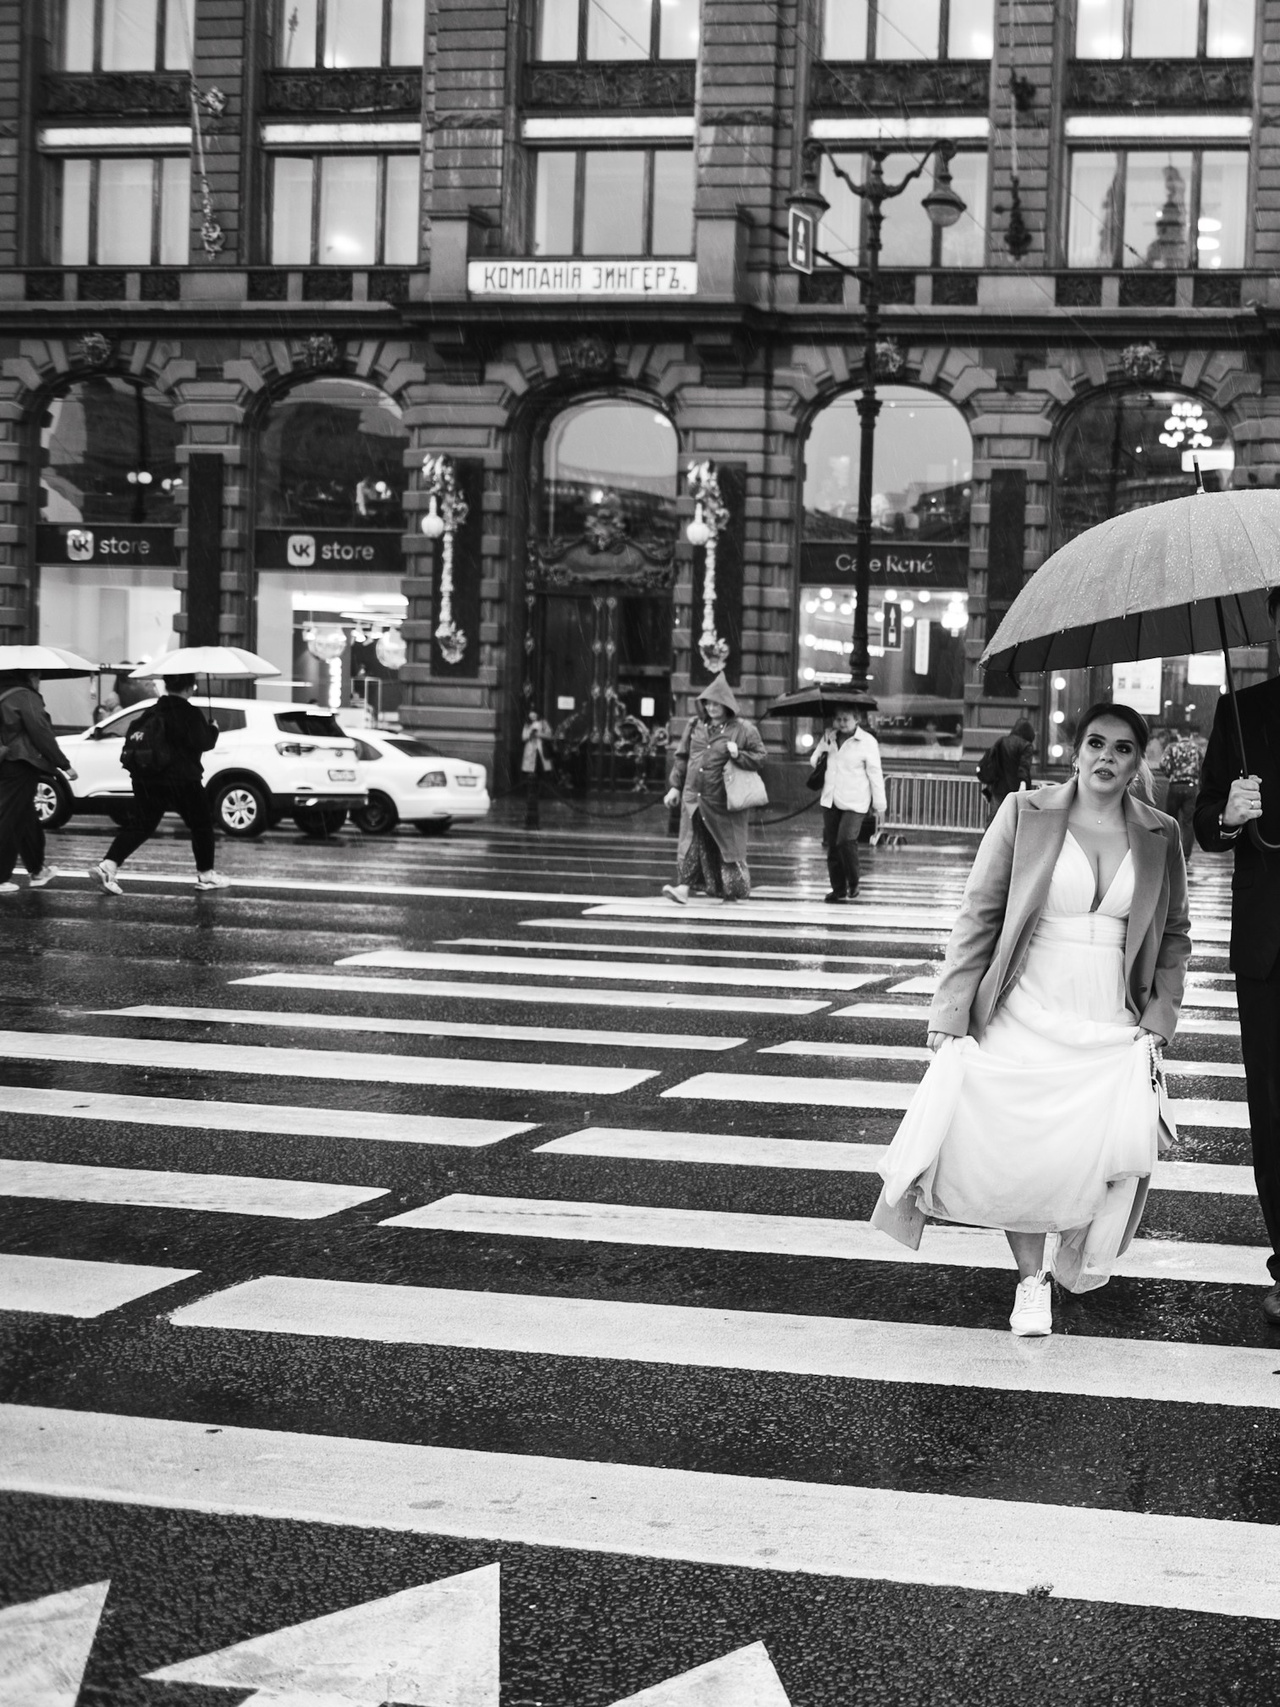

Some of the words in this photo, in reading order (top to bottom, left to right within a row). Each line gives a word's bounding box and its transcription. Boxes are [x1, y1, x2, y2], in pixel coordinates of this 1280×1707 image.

[485, 267, 582, 289] КОМПАНІЯ
[99, 536, 150, 554] store
[321, 541, 375, 560] store
[835, 554, 882, 572] Cae
[886, 553, 934, 573] René
